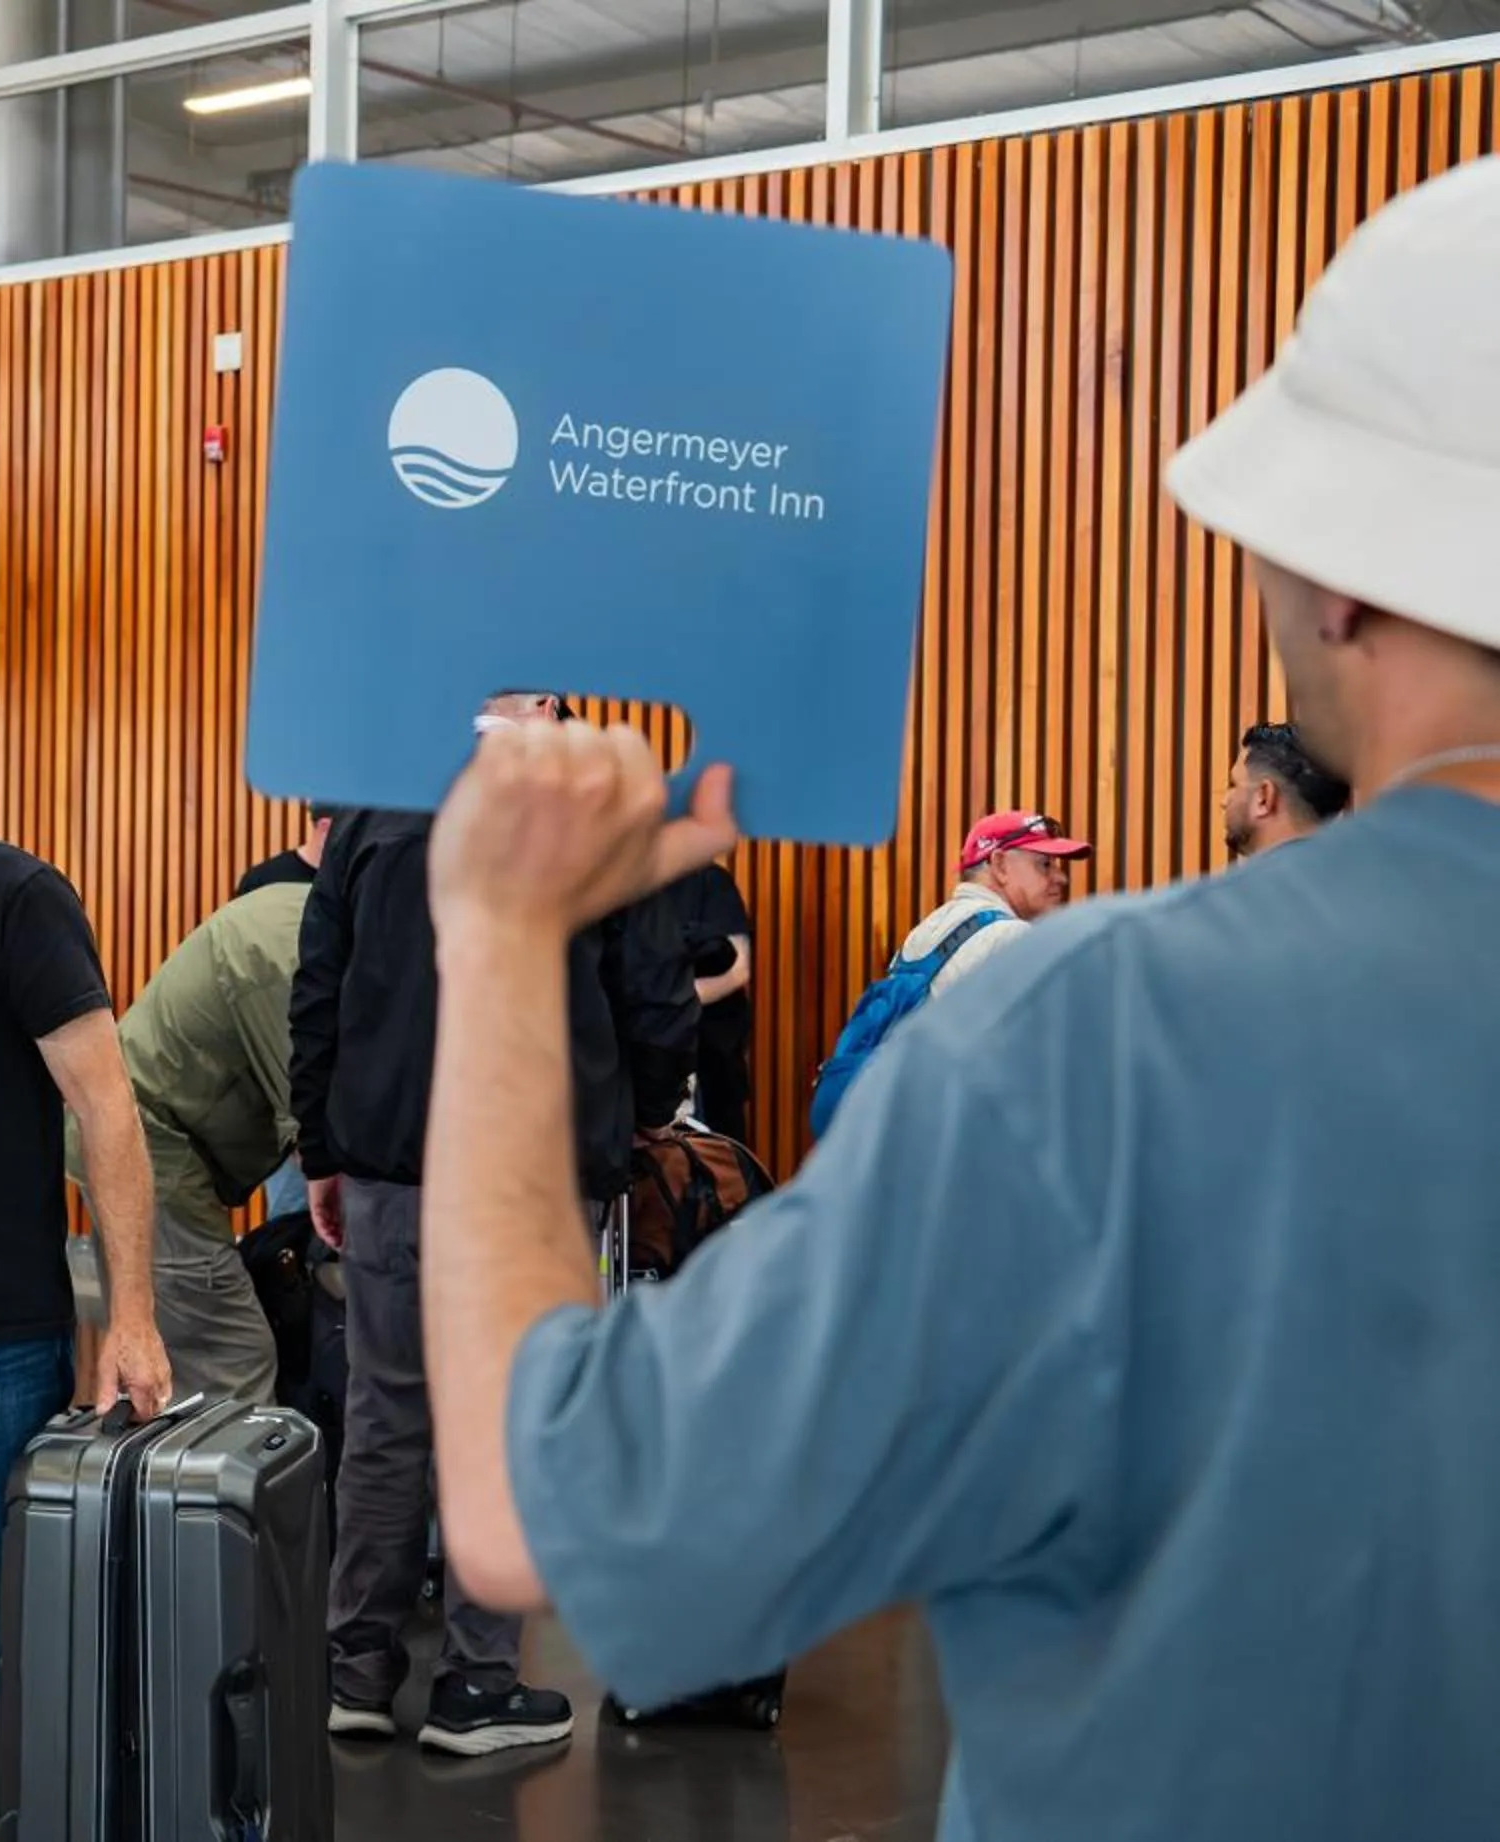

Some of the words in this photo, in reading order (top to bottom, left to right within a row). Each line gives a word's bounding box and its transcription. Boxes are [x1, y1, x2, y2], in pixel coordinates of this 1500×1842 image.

[550, 413, 789, 471] Angermeyer
[549, 459, 757, 513] Waterfront
[769, 483, 824, 519] Inn
